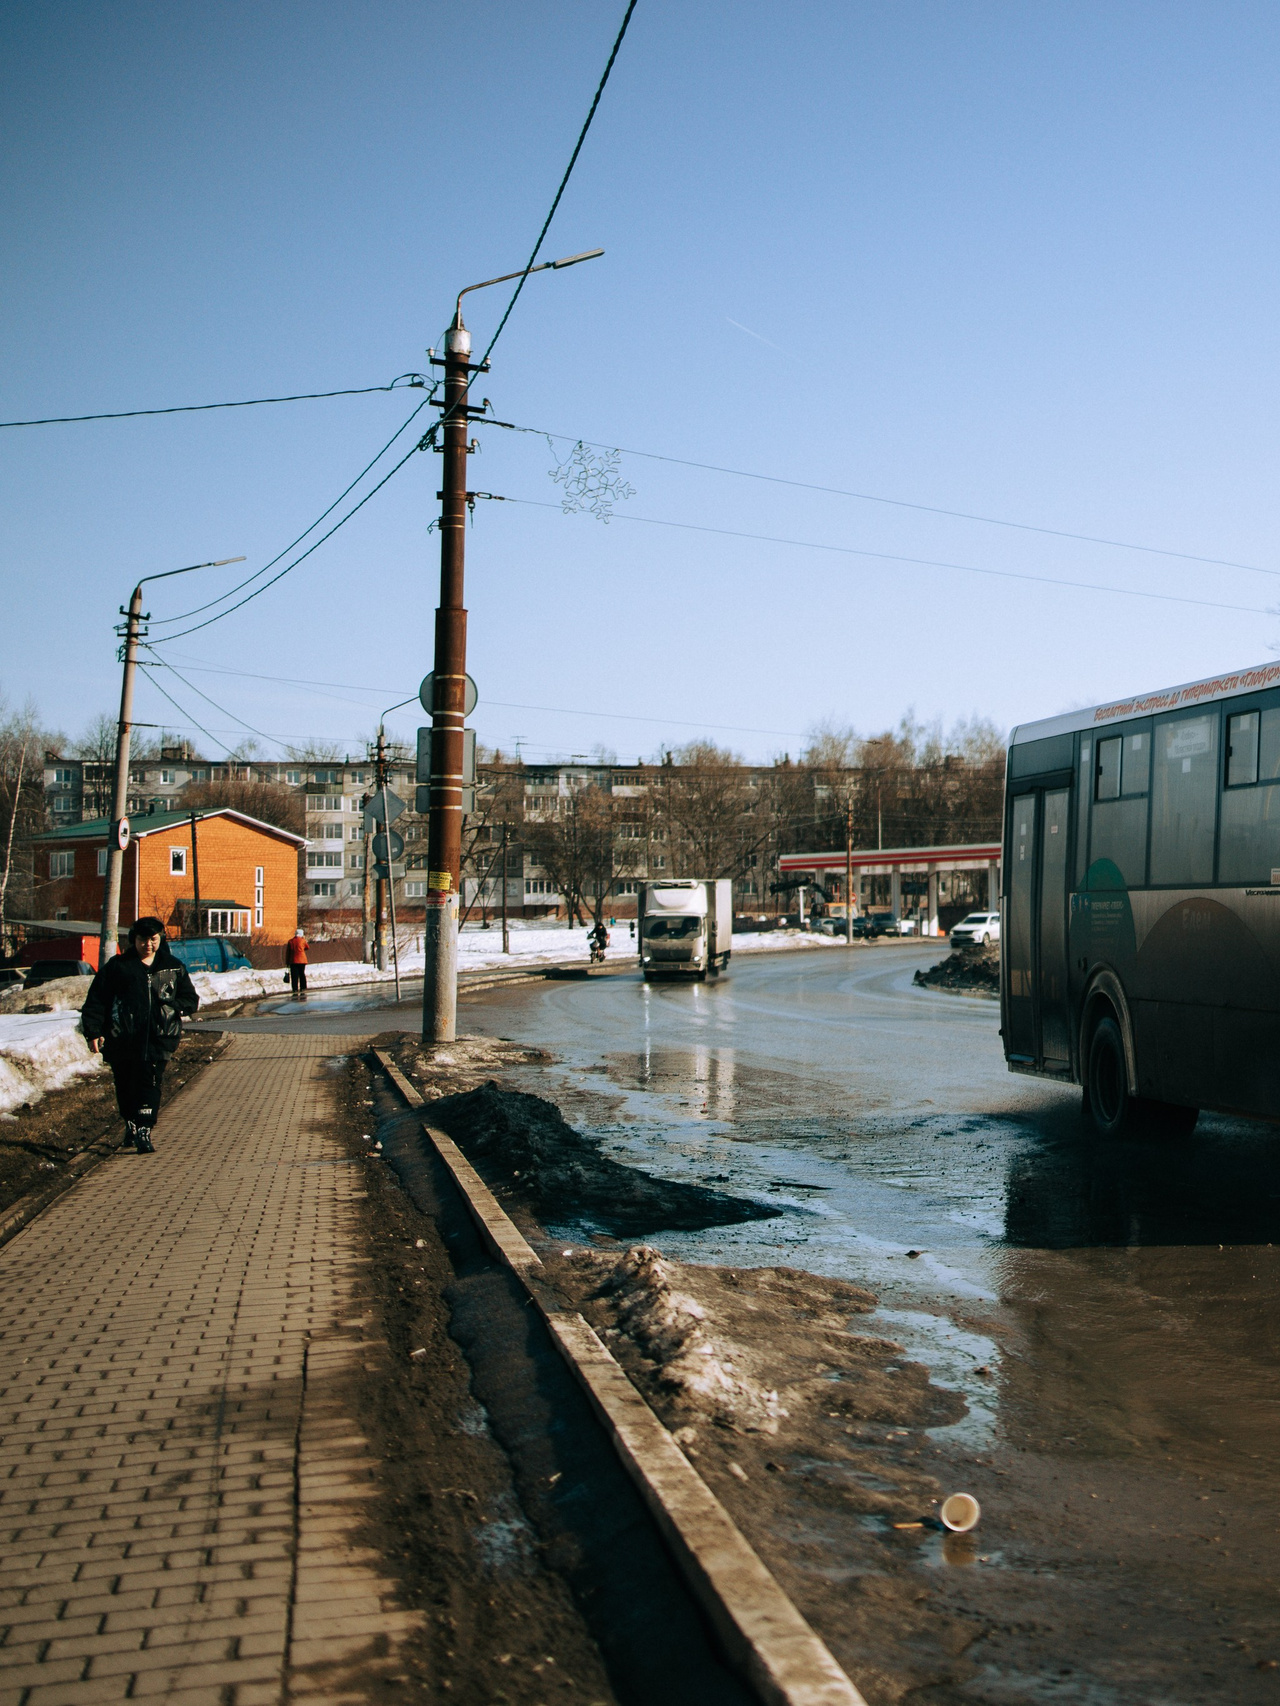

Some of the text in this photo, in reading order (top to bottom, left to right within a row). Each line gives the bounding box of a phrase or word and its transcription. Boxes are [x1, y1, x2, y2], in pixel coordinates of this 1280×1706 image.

[1134, 693, 1170, 714] экспресс
[1167, 690, 1181, 707] до
[1181, 676, 1239, 701] гипермаркета
